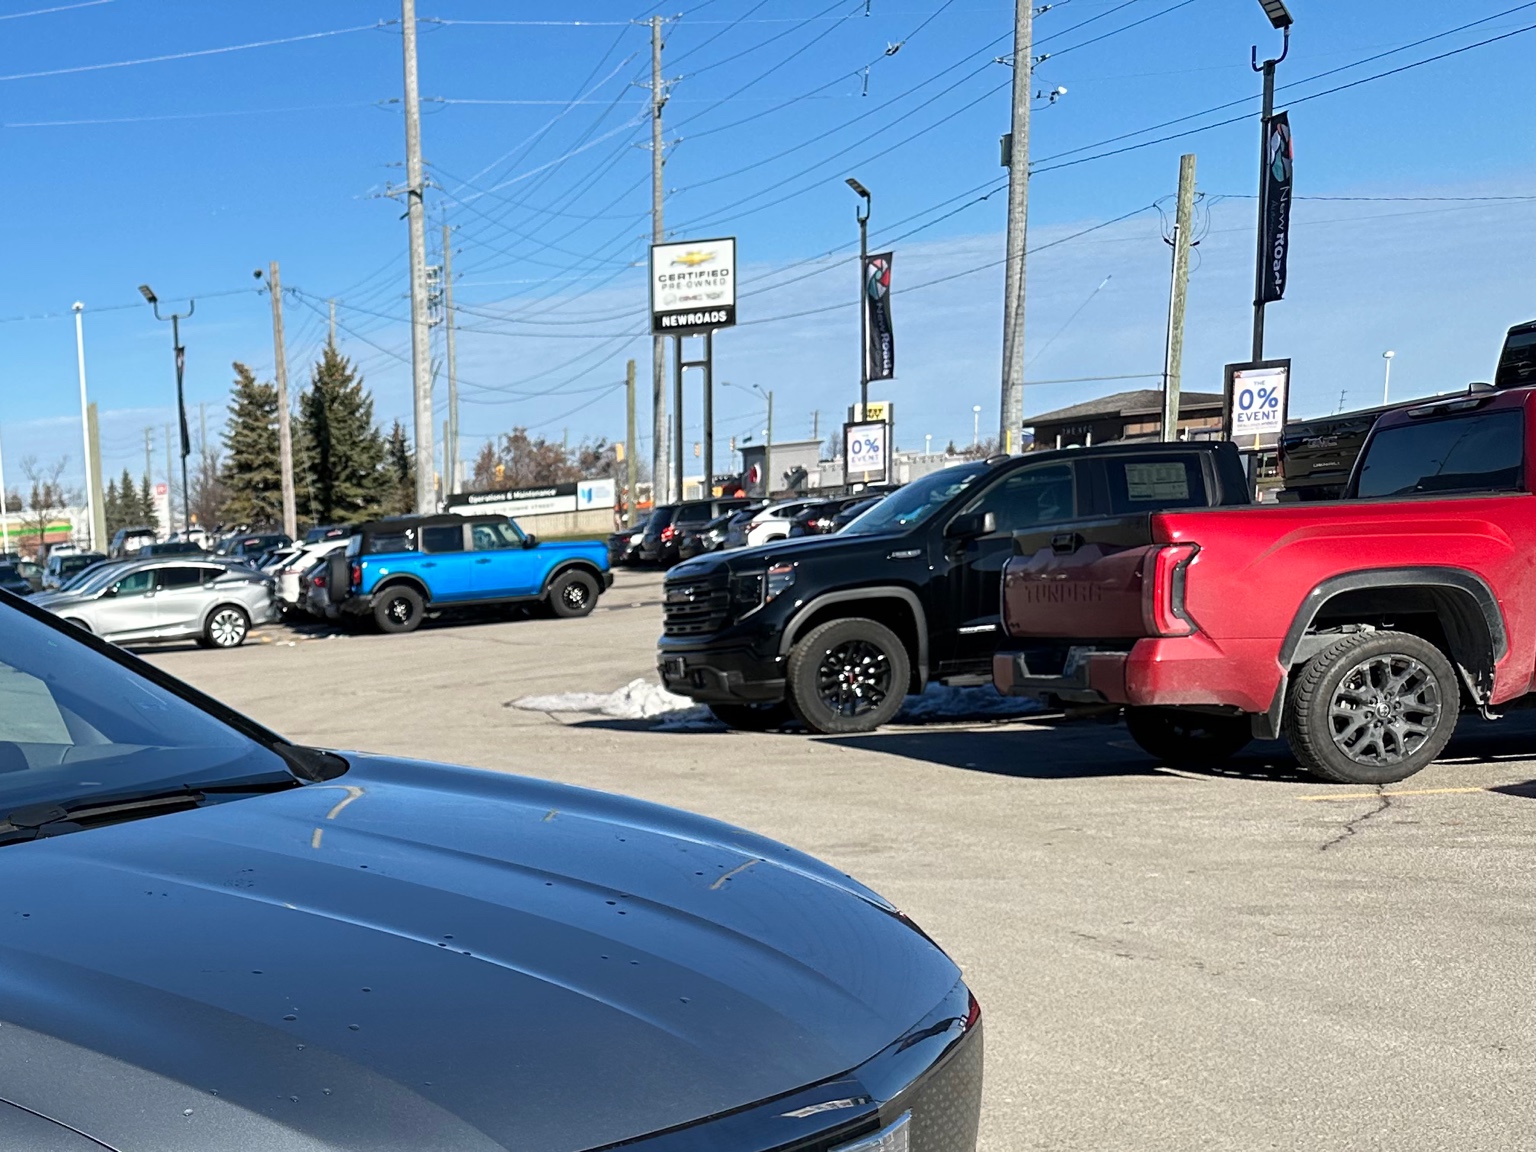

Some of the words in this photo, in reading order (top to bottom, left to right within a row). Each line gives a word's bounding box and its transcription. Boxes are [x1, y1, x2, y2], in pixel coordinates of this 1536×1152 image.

[658, 269, 729, 283] CERTIFIED
[662, 310, 728, 327] NEWROADS
[1238, 386, 1279, 411] 0%
[1237, 409, 1278, 422] EVENT
[852, 438, 880, 455] 0%
[851, 454, 879, 463] EVENT
[468, 492, 505, 504] Operations
[506, 491, 513, 500] &
[513, 488, 558, 499] Maintenance
[1025, 582, 1102, 603] TUNDRA
